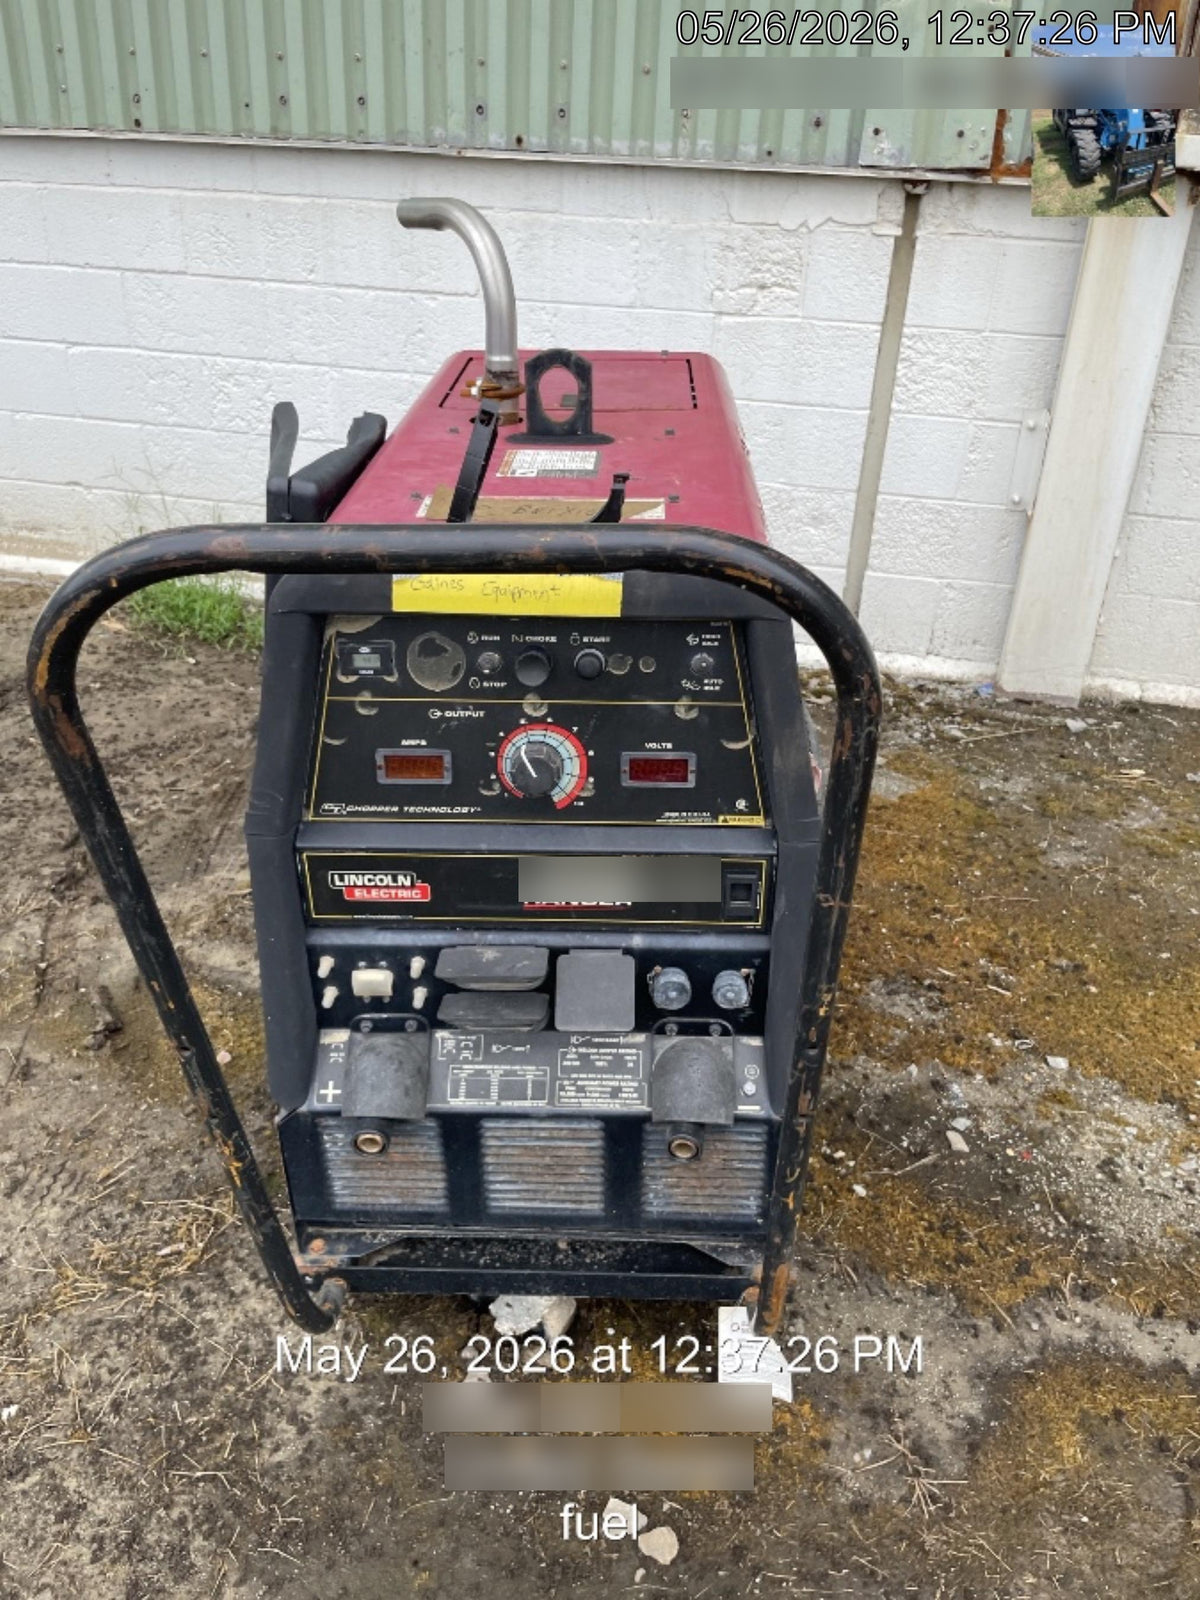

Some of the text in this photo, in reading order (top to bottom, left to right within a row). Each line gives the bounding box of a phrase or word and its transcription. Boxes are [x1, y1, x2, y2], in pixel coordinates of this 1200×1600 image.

[444, 709, 486, 718] OUTPUT
[346, 804, 399, 812] CHOPPER
[403, 806, 478, 814] TECHNOLOGY
[333, 874, 411, 886] LINCOLN
[353, 888, 423, 898] ELECTRIC
